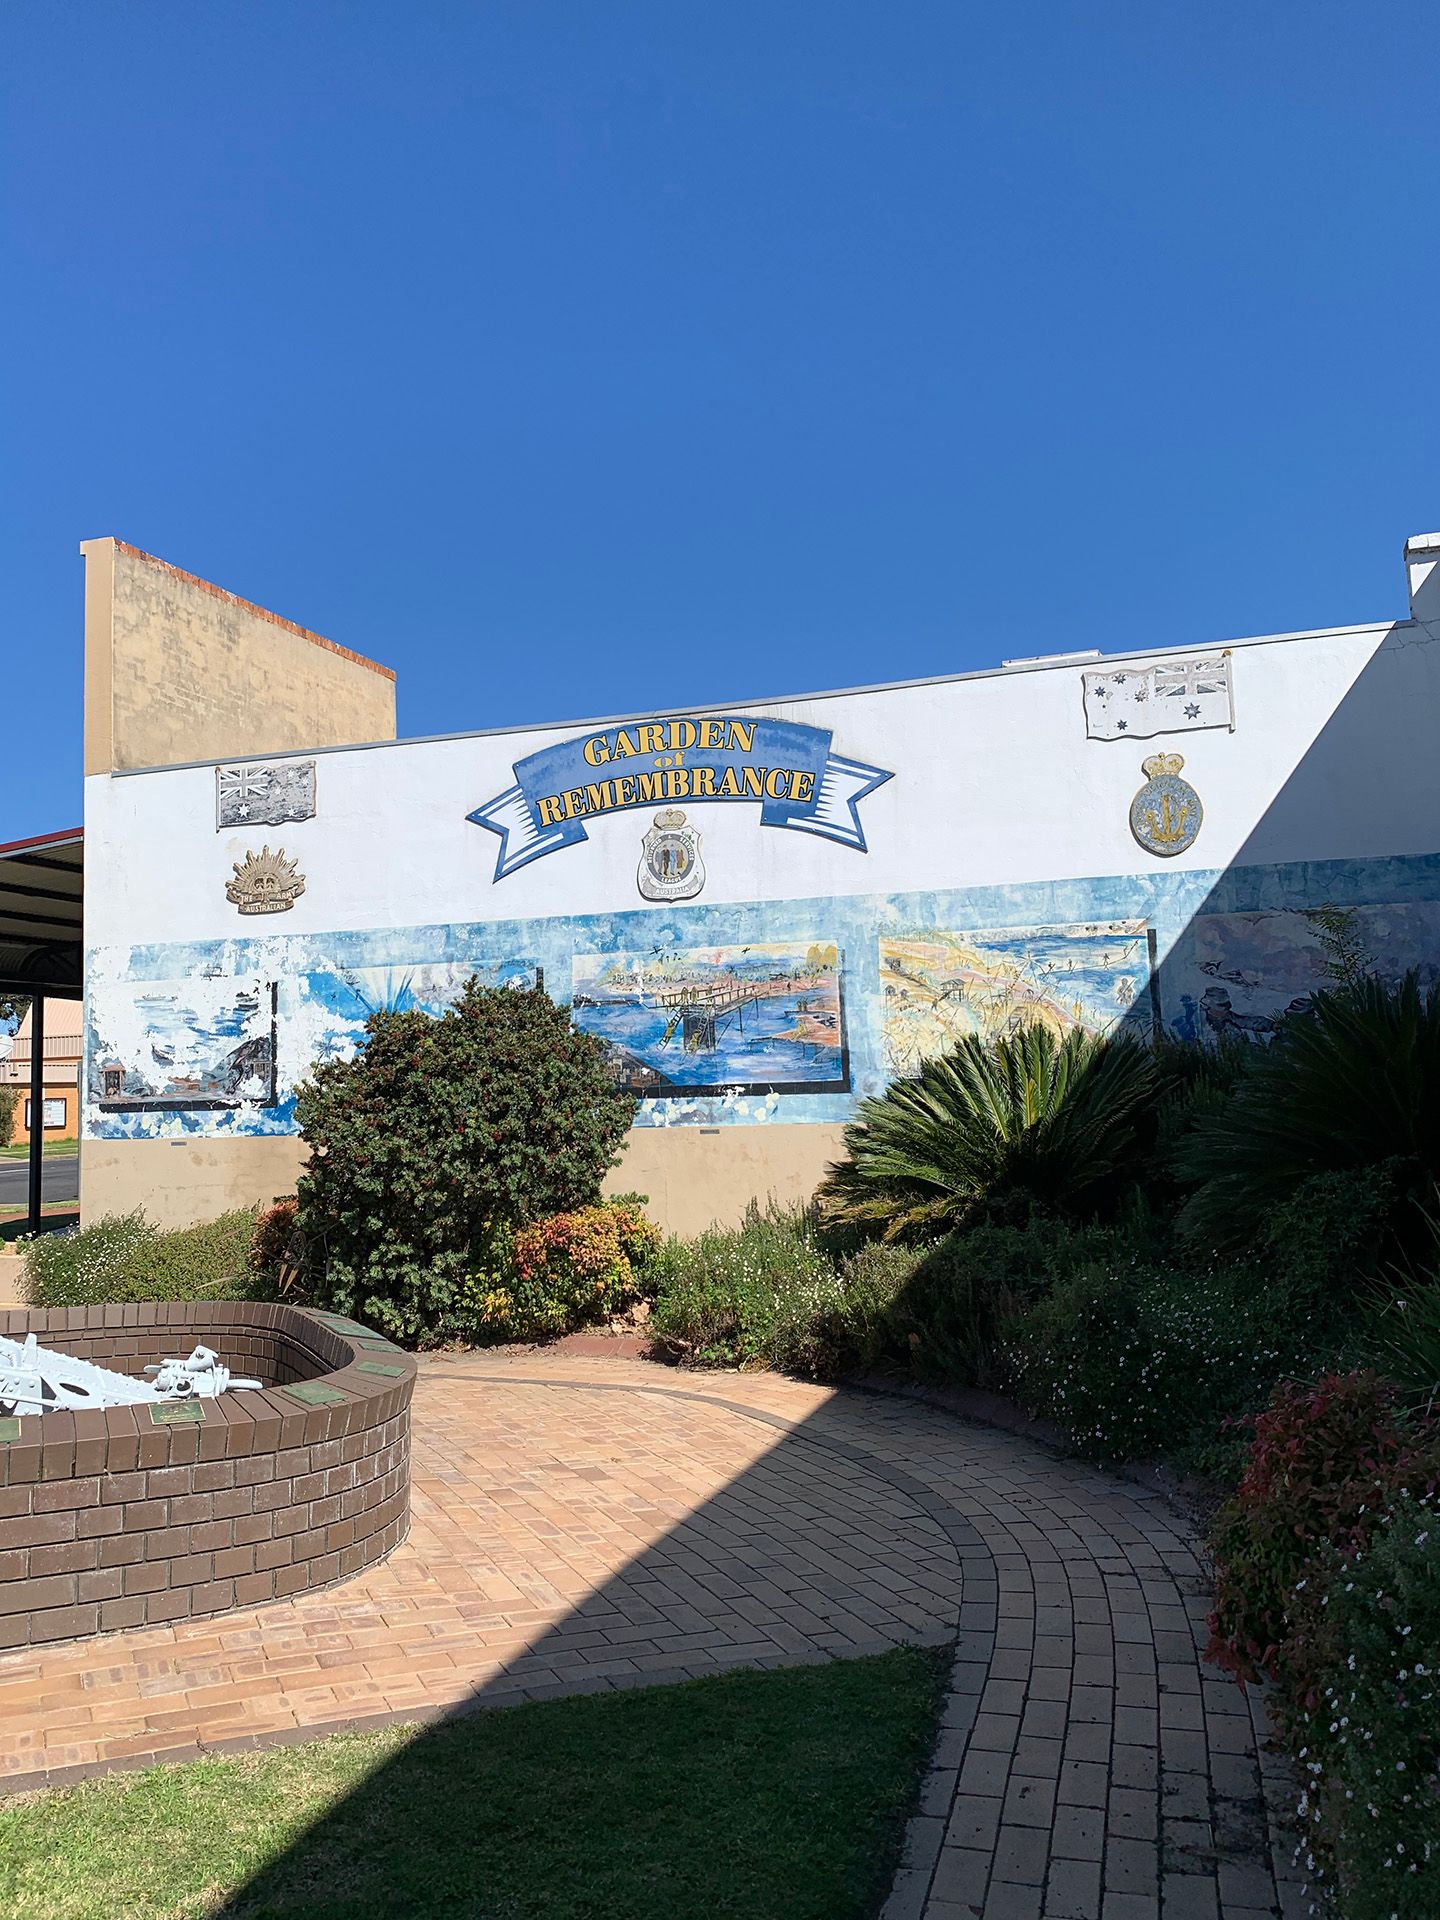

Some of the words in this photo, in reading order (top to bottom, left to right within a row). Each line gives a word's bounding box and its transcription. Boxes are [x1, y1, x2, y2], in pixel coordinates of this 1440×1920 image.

[583, 719, 757, 767] GARDEN
[653, 751, 685, 768] of
[536, 766, 816, 827] REMEMBRANCE
[679, 836, 695, 861] SERVICES
[661, 876, 682, 884] LEAGUE
[276, 890, 296, 899] ARMY
[655, 886, 690, 895] AUSTRALIA
[245, 903, 286, 912] AUSTRALIAN
